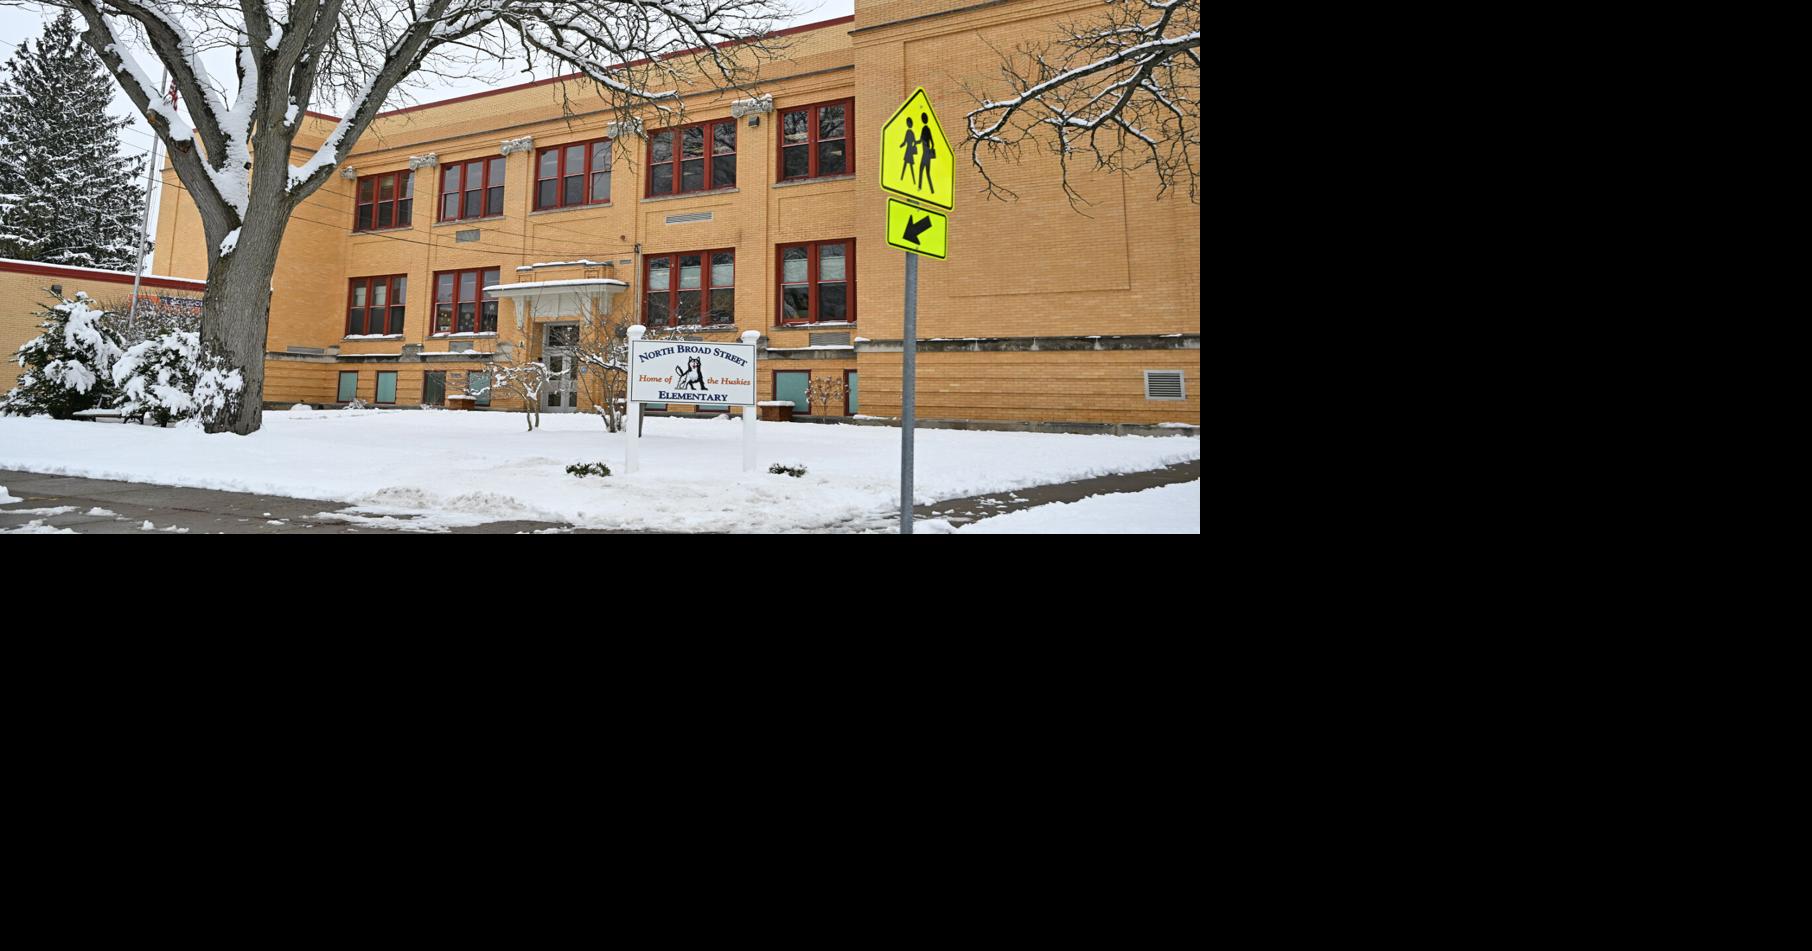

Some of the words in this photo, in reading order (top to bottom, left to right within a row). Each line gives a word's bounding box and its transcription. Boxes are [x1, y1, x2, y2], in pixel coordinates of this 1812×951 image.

[639, 347, 674, 362] NORTH
[677, 345, 711, 354] BROAD
[713, 347, 748, 367] STREET
[639, 374, 662, 383] Home
[664, 375, 673, 383] of
[707, 377, 719, 385] the
[721, 377, 751, 386] Huskies
[658, 390, 728, 402] ELEMENTARY
